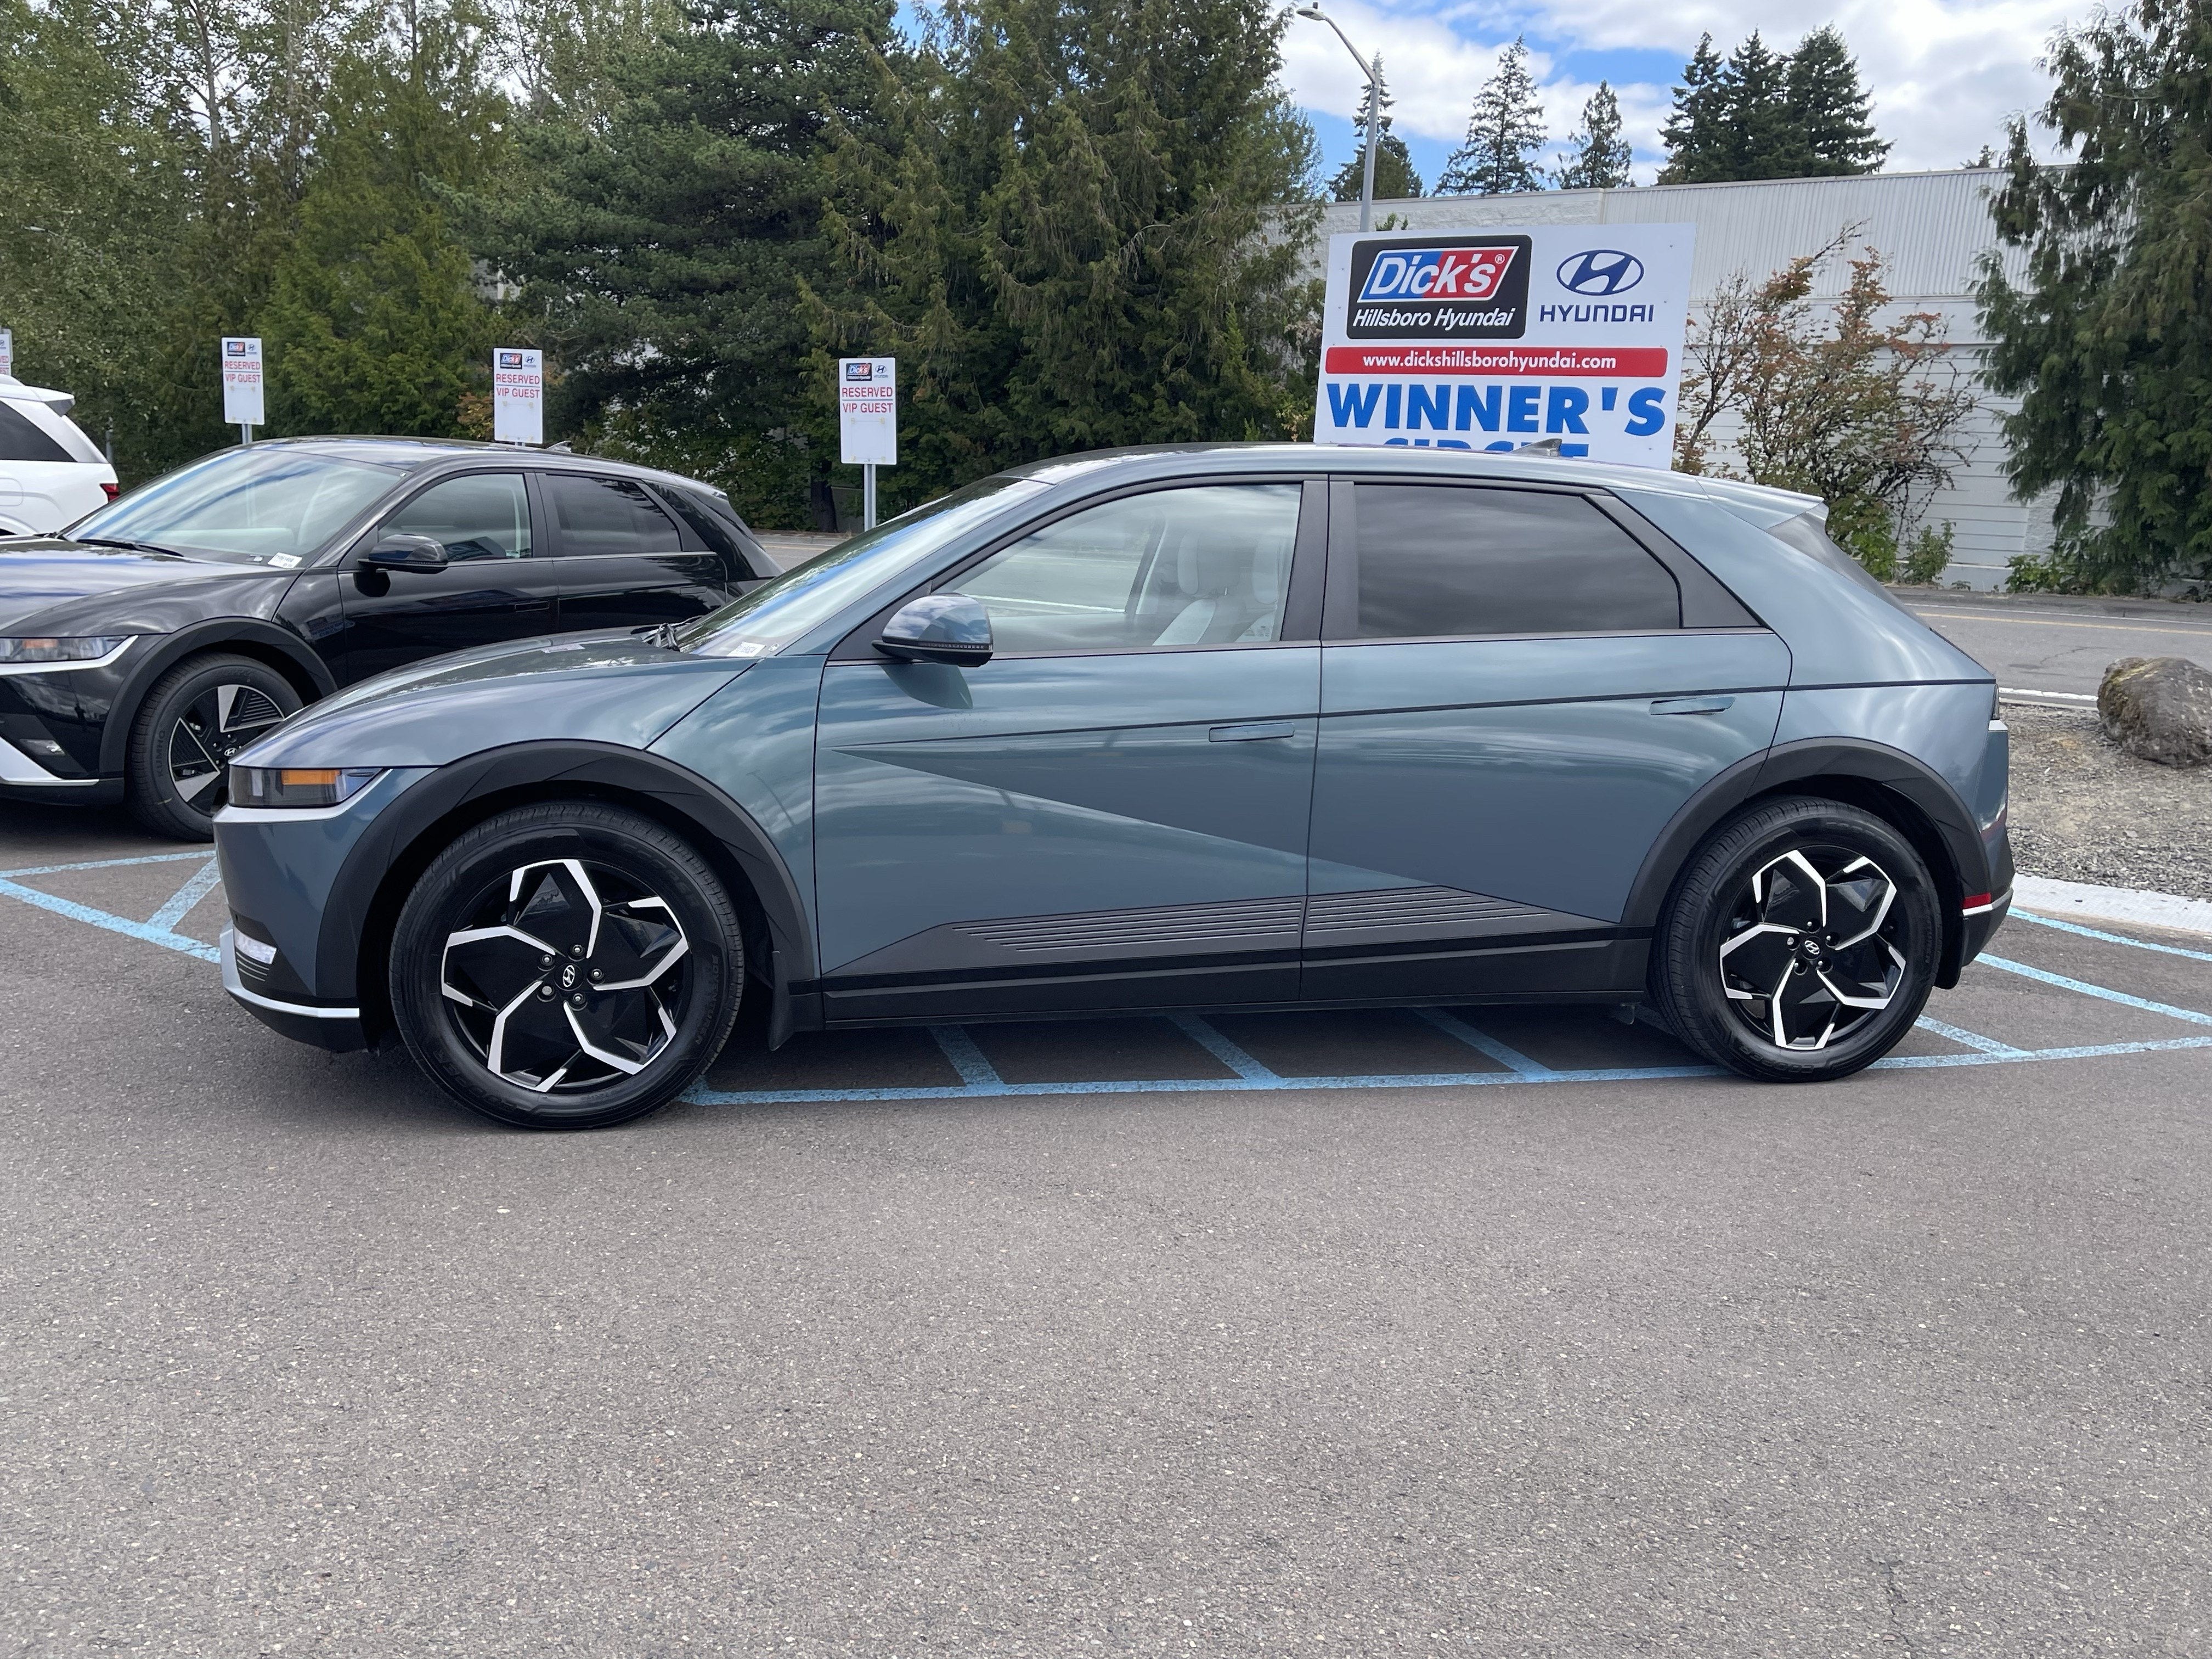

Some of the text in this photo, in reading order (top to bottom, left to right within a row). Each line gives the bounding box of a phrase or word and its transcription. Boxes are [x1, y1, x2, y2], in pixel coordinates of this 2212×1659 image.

[1369, 253, 1496, 294] Dick's
[1540, 304, 1654, 323] HYUNDAI
[1353, 308, 1516, 331] Hillsboro Hyundai
[224, 361, 261, 370] RESERVED
[1362, 351, 1617, 372] www.dickshillsborohyundai.com
[225, 374, 261, 383] VIP GUEST
[496, 374, 540, 385] RESERVED
[496, 387, 540, 398] VIP GUEST
[842, 387, 893, 397] RESERVED
[843, 403, 893, 413] VIP GUEST
[1326, 383, 1667, 436] WINNER'S
